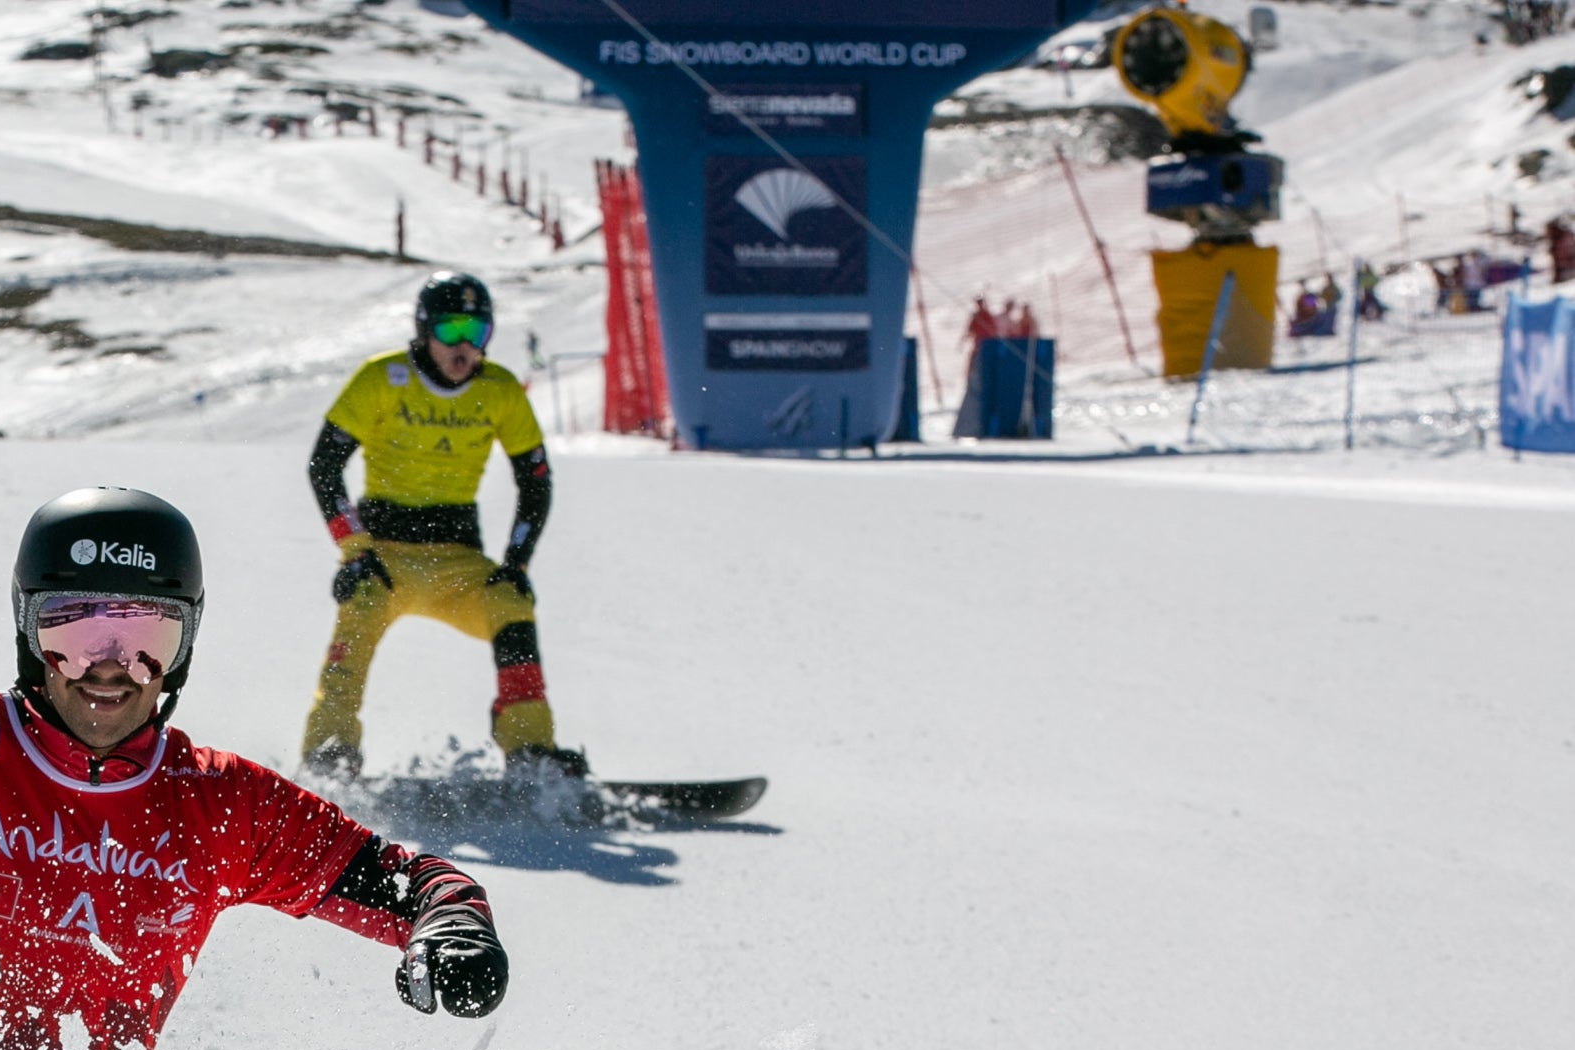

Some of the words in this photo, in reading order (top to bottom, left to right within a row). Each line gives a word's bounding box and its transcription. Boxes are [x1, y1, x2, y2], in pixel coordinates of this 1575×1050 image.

[599, 40, 642, 65] FIS
[645, 41, 811, 66] SNOWBOARD
[813, 42, 908, 67] WORLD
[910, 42, 968, 67] CUP
[100, 541, 156, 571] Kalia
